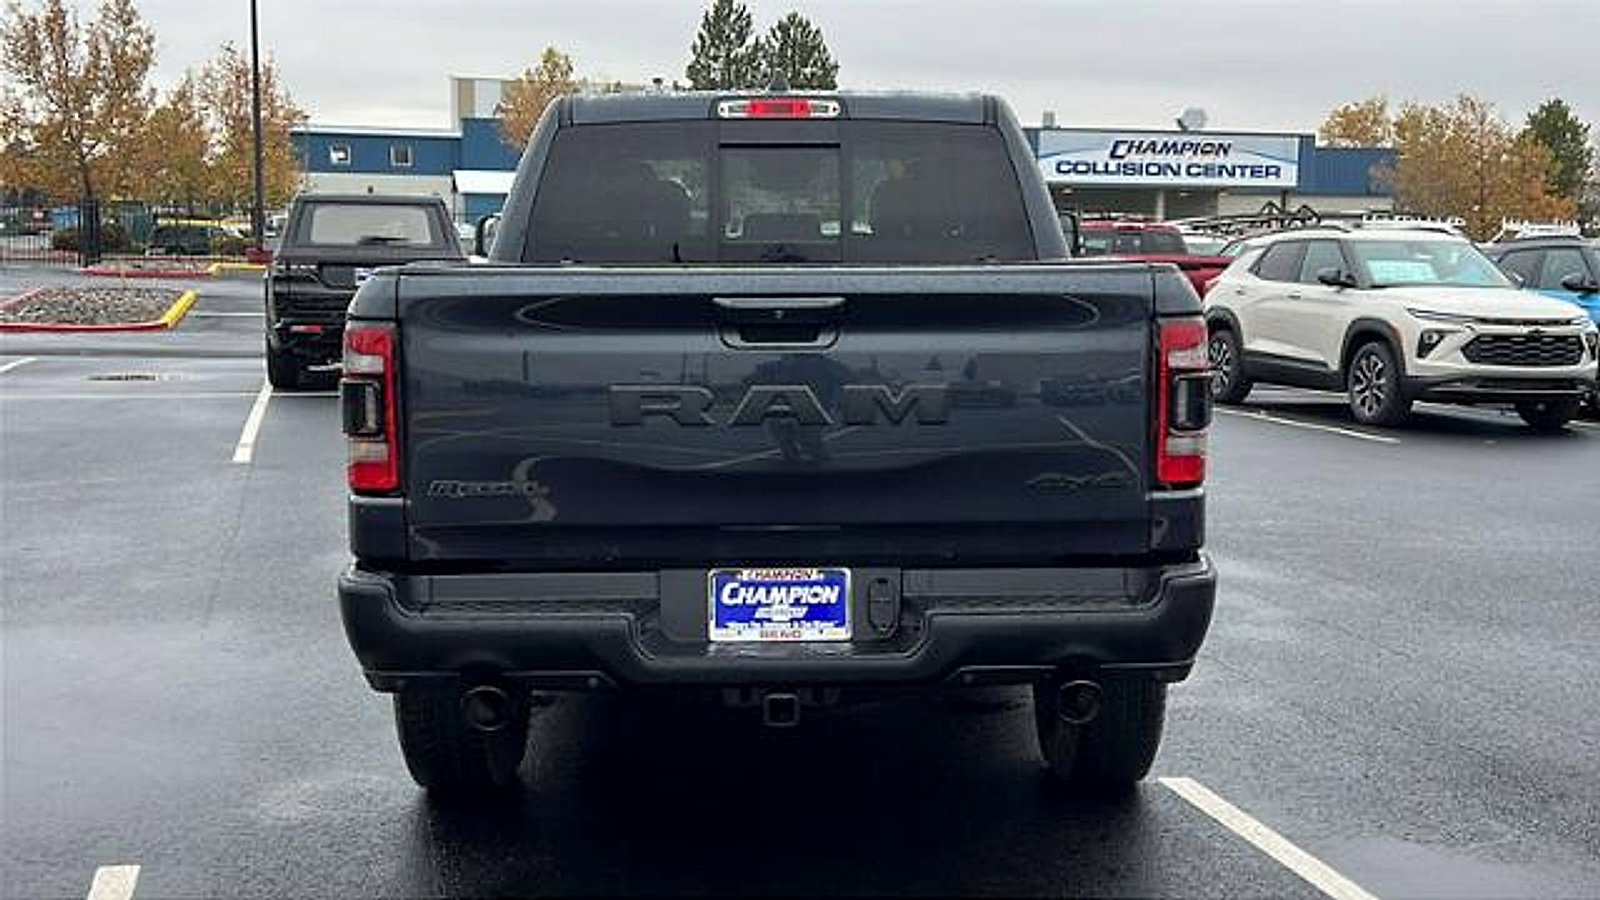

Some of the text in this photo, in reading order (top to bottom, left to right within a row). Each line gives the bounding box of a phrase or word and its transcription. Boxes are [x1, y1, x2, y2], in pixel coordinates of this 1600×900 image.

[1110, 140, 1231, 159] CHAMPION
[1056, 161, 1282, 179] COLLISION CENTER
[608, 383, 951, 427] RAM
[722, 582, 839, 605] CHAMPION
